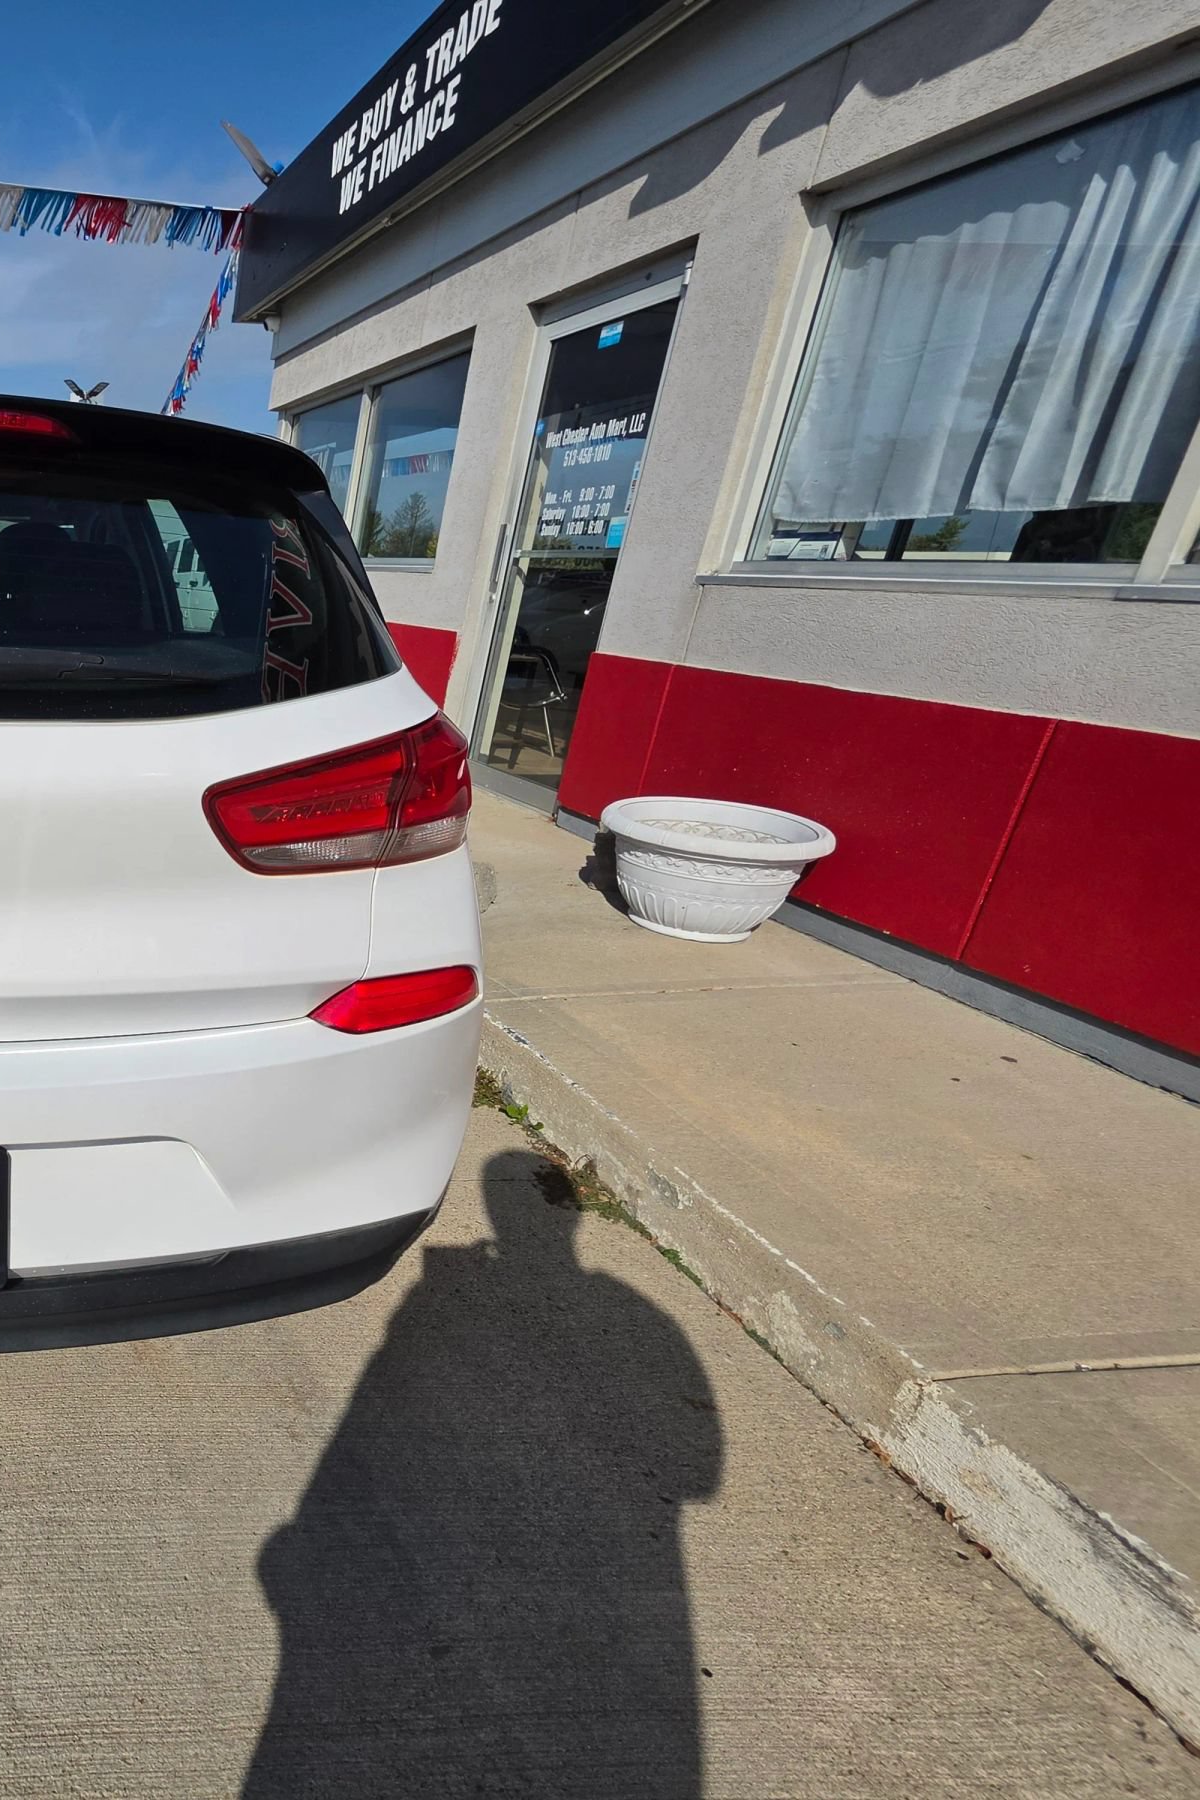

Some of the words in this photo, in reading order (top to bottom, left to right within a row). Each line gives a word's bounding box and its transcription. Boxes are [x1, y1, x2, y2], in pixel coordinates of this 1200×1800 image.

[331, 120, 358, 179] WE
[358, 78, 399, 153] BUY
[400, 63, 417, 115] &
[425, 0, 503, 93] TRADE
[338, 157, 367, 215] WE
[368, 73, 462, 192] FINANCE
[546, 431, 563, 449] West
[589, 422, 607, 440] Auto
[629, 412, 646, 433] LLC
